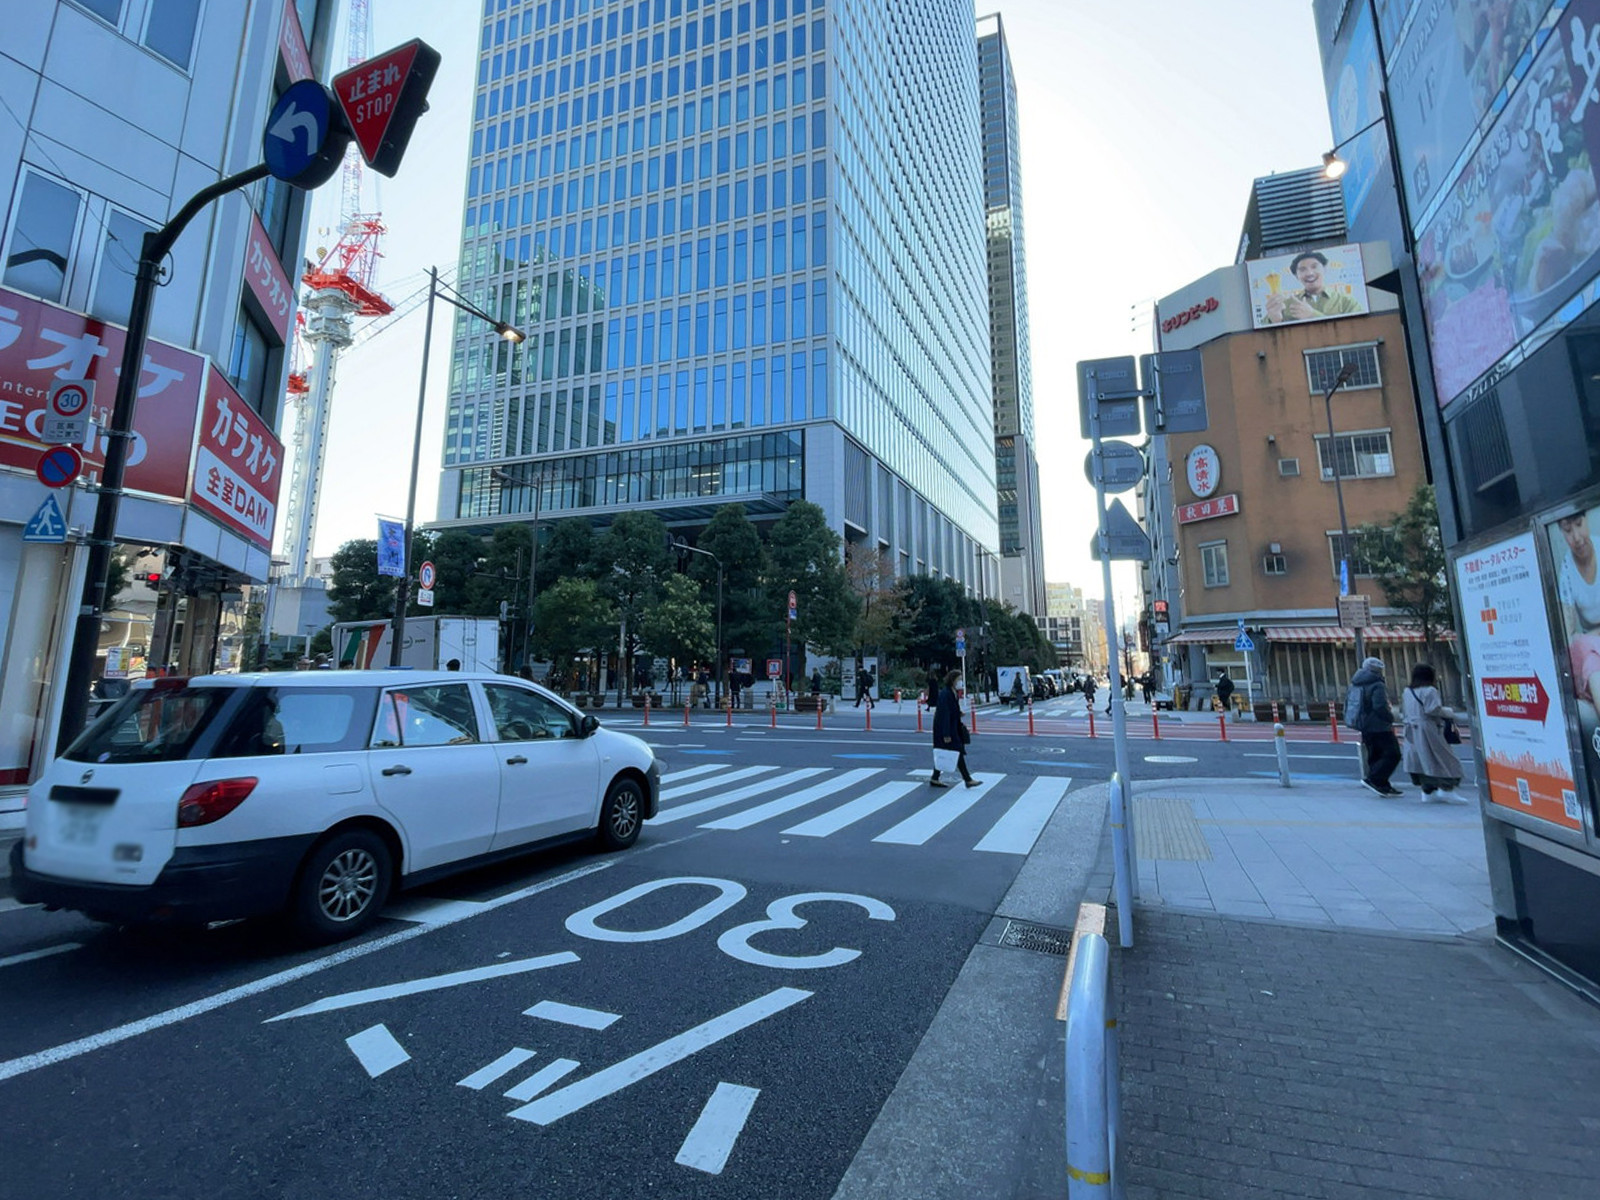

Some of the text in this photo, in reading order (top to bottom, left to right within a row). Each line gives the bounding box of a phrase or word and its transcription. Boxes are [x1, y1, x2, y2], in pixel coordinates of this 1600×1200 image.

[348, 63, 401, 103] 止まれ
[355, 93, 393, 124] STOP
[249, 241, 291, 317] カラオケ
[1161, 297, 1219, 333] キリンビール
[59, 393, 81, 408] 30
[211, 396, 278, 484] カラオケ
[205, 465, 269, 529] 全室DAM
[1185, 498, 1228, 520] 秋田屋
